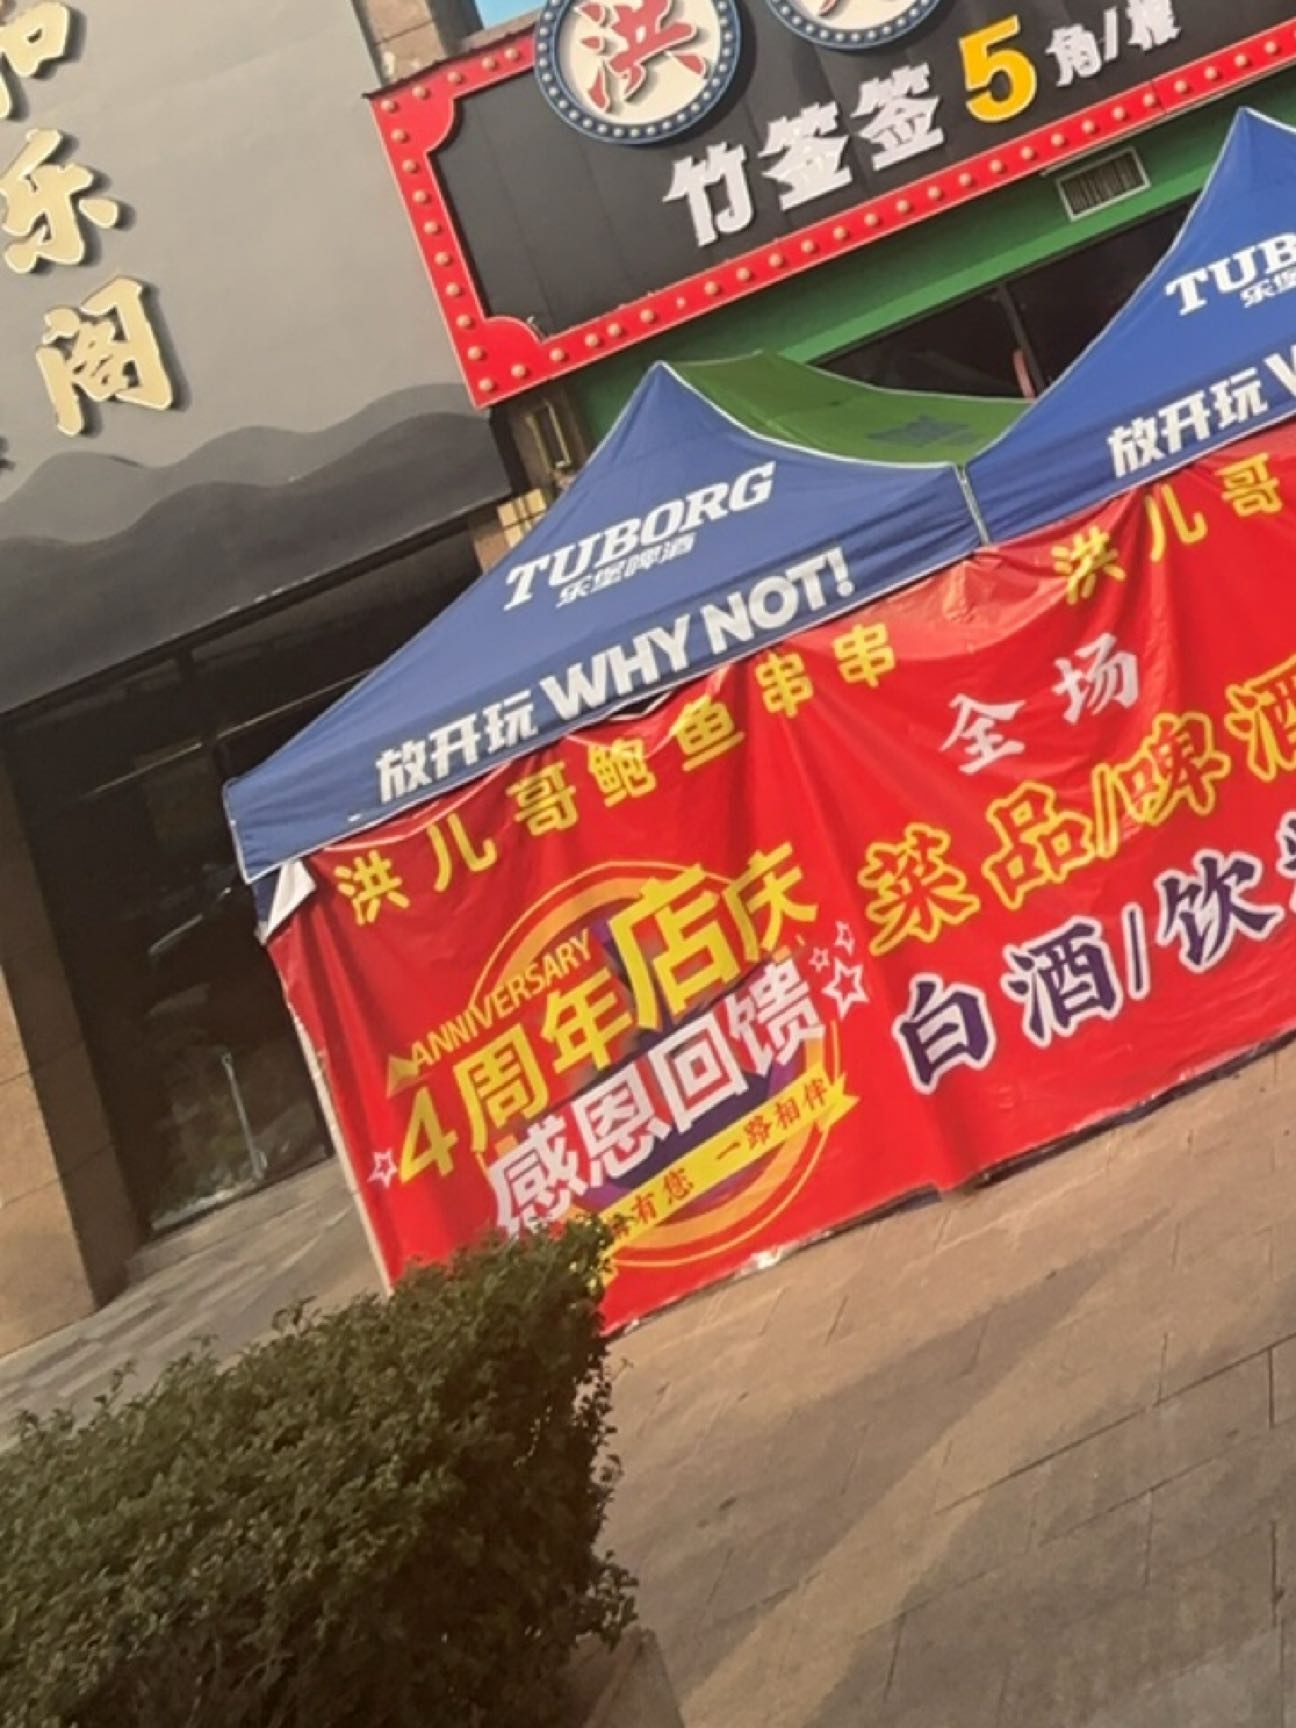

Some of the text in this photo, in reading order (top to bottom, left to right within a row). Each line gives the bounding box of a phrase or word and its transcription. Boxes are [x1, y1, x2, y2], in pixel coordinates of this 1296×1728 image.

[1107, 368, 1268, 478] 放开玩
[502, 462, 776, 611] TUBORG
[375, 547, 856, 804] 放开玩 WHY NOT!
[939, 632, 1140, 775] 全场
[335, 622, 896, 926] 洪儿哥鲍鱼串串
[398, 843, 820, 1183] 4周年店庆
[411, 929, 594, 1069] ANNIVERSARY
[487, 957, 826, 1239] 感恩回馈
[714, 1076, 830, 1159] 一路相伴
